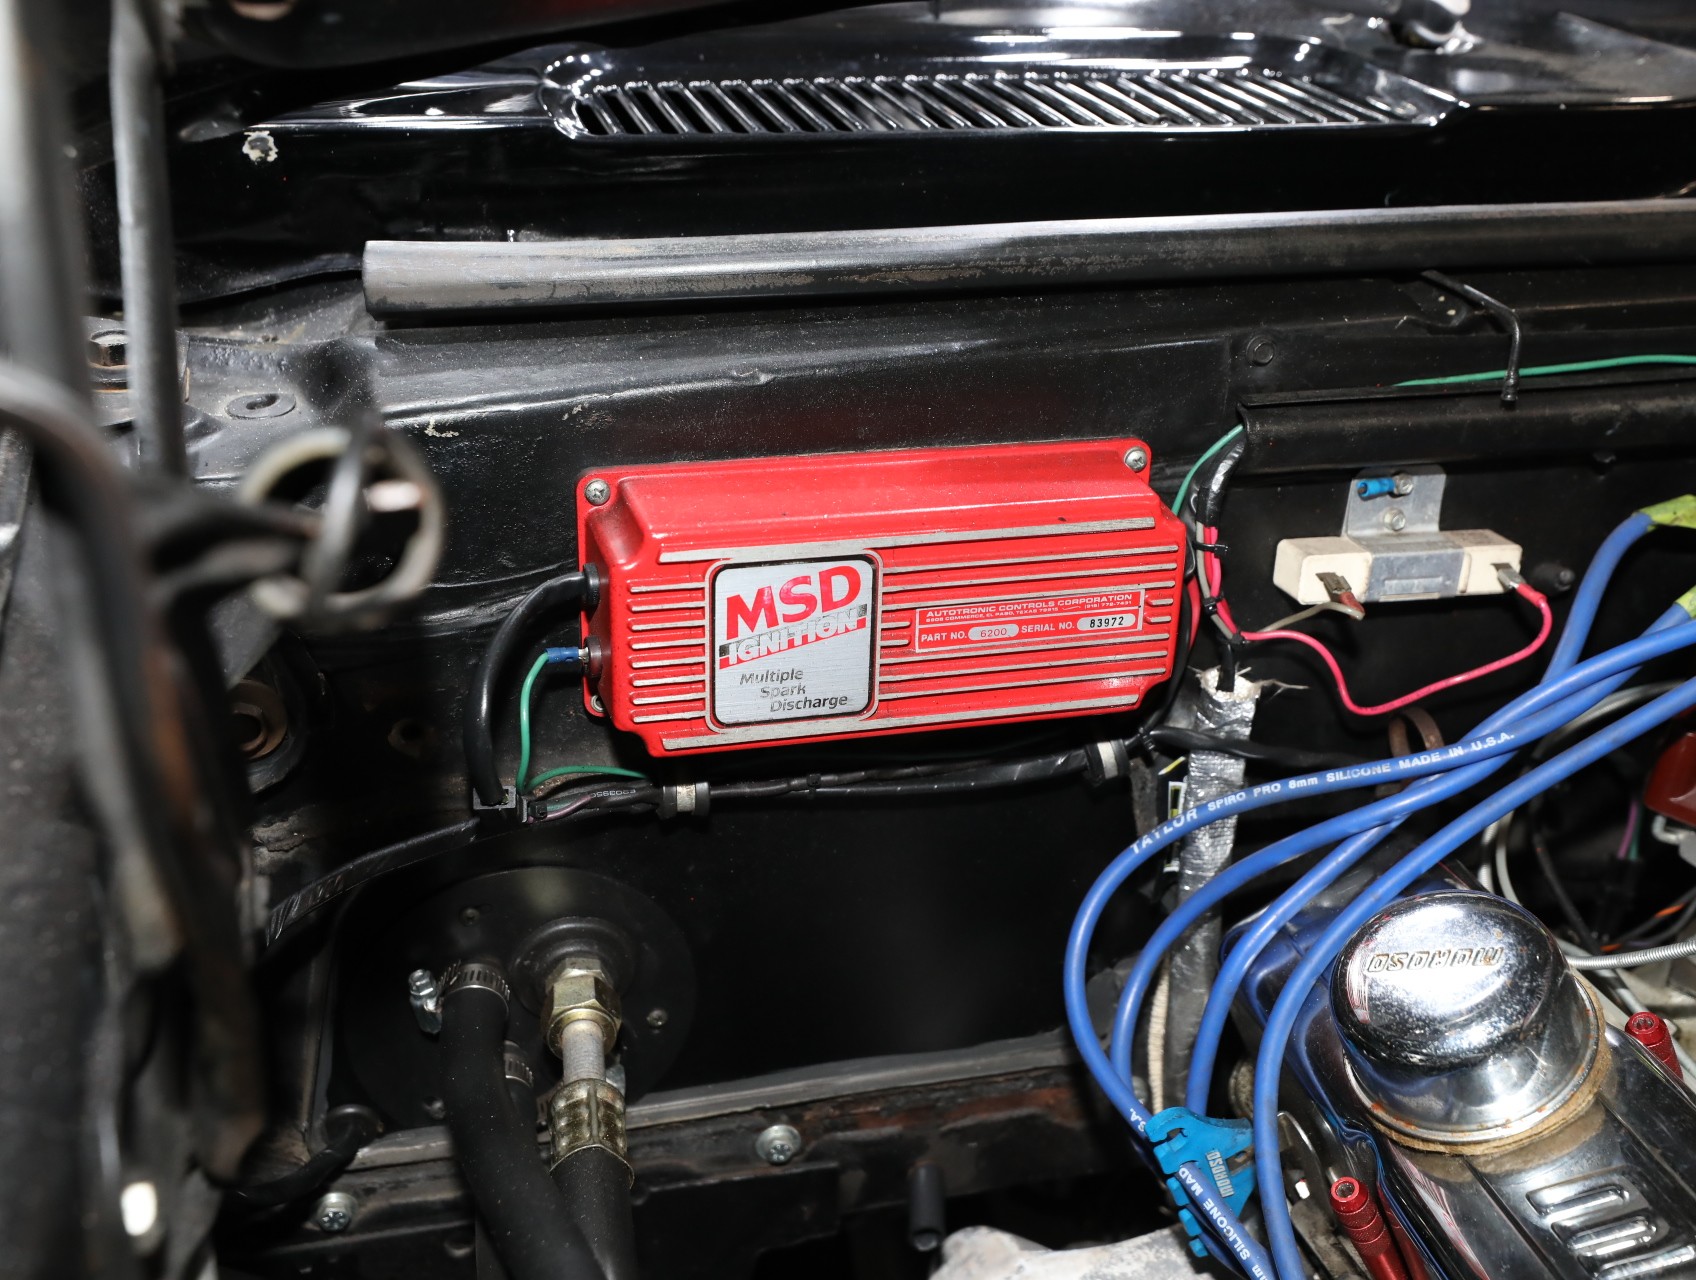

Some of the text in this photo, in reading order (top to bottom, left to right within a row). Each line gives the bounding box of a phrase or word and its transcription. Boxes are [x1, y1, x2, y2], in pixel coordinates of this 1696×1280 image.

[726, 565, 862, 640] MSD
[926, 594, 1132, 617] AUTOTRONIC CONTROLS CORPORATION
[727, 607, 858, 665] IGNITION
[921, 616, 1124, 642] PART NO. 6200 SERIAL NO. 83972
[740, 668, 804, 686] Multiple
[760, 683, 806, 699] Spark
[770, 695, 848, 712] Discharge
[1207, 791, 1246, 812] SPIRO
[1253, 782, 1281, 798] PRO
[1288, 777, 1318, 790] 8mm
[1326, 763, 1392, 782] SILICONE
[1398, 752, 1442, 769] MADE
[1448, 745, 1465, 758] IN
[1471, 732, 1515, 751] U.S.A.
[1367, 946, 1504, 973] MOROSO
[1179, 1167, 1204, 1197] MAD
[1206, 1149, 1235, 1198] MOROSO
[1203, 1198, 1250, 1260] SILICONE
